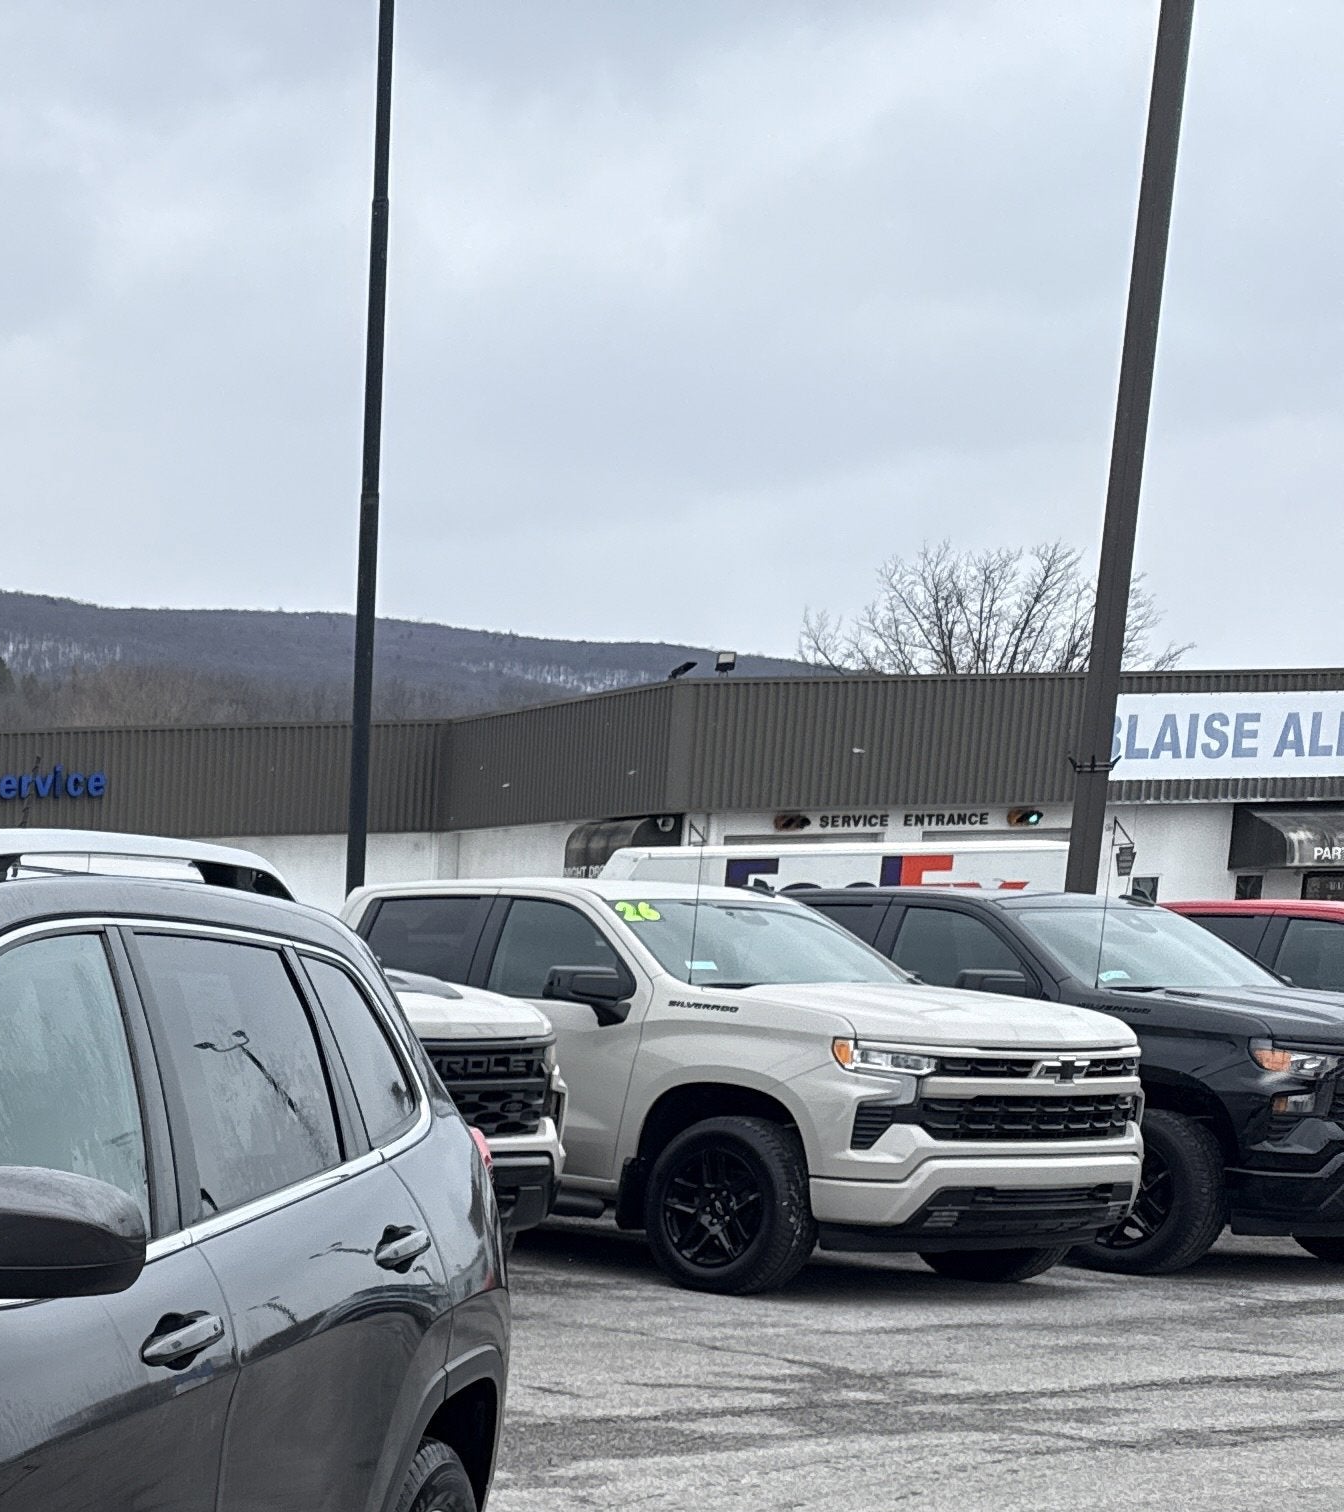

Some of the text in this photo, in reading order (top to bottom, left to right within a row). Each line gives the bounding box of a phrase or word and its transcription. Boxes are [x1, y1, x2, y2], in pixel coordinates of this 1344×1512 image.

[819, 812, 989, 828] SERVICE ENTRANCE
[615, 902, 661, 921] 26
[668, 1000, 739, 1013] SILVERADO
[433, 1053, 544, 1074] ROLET
